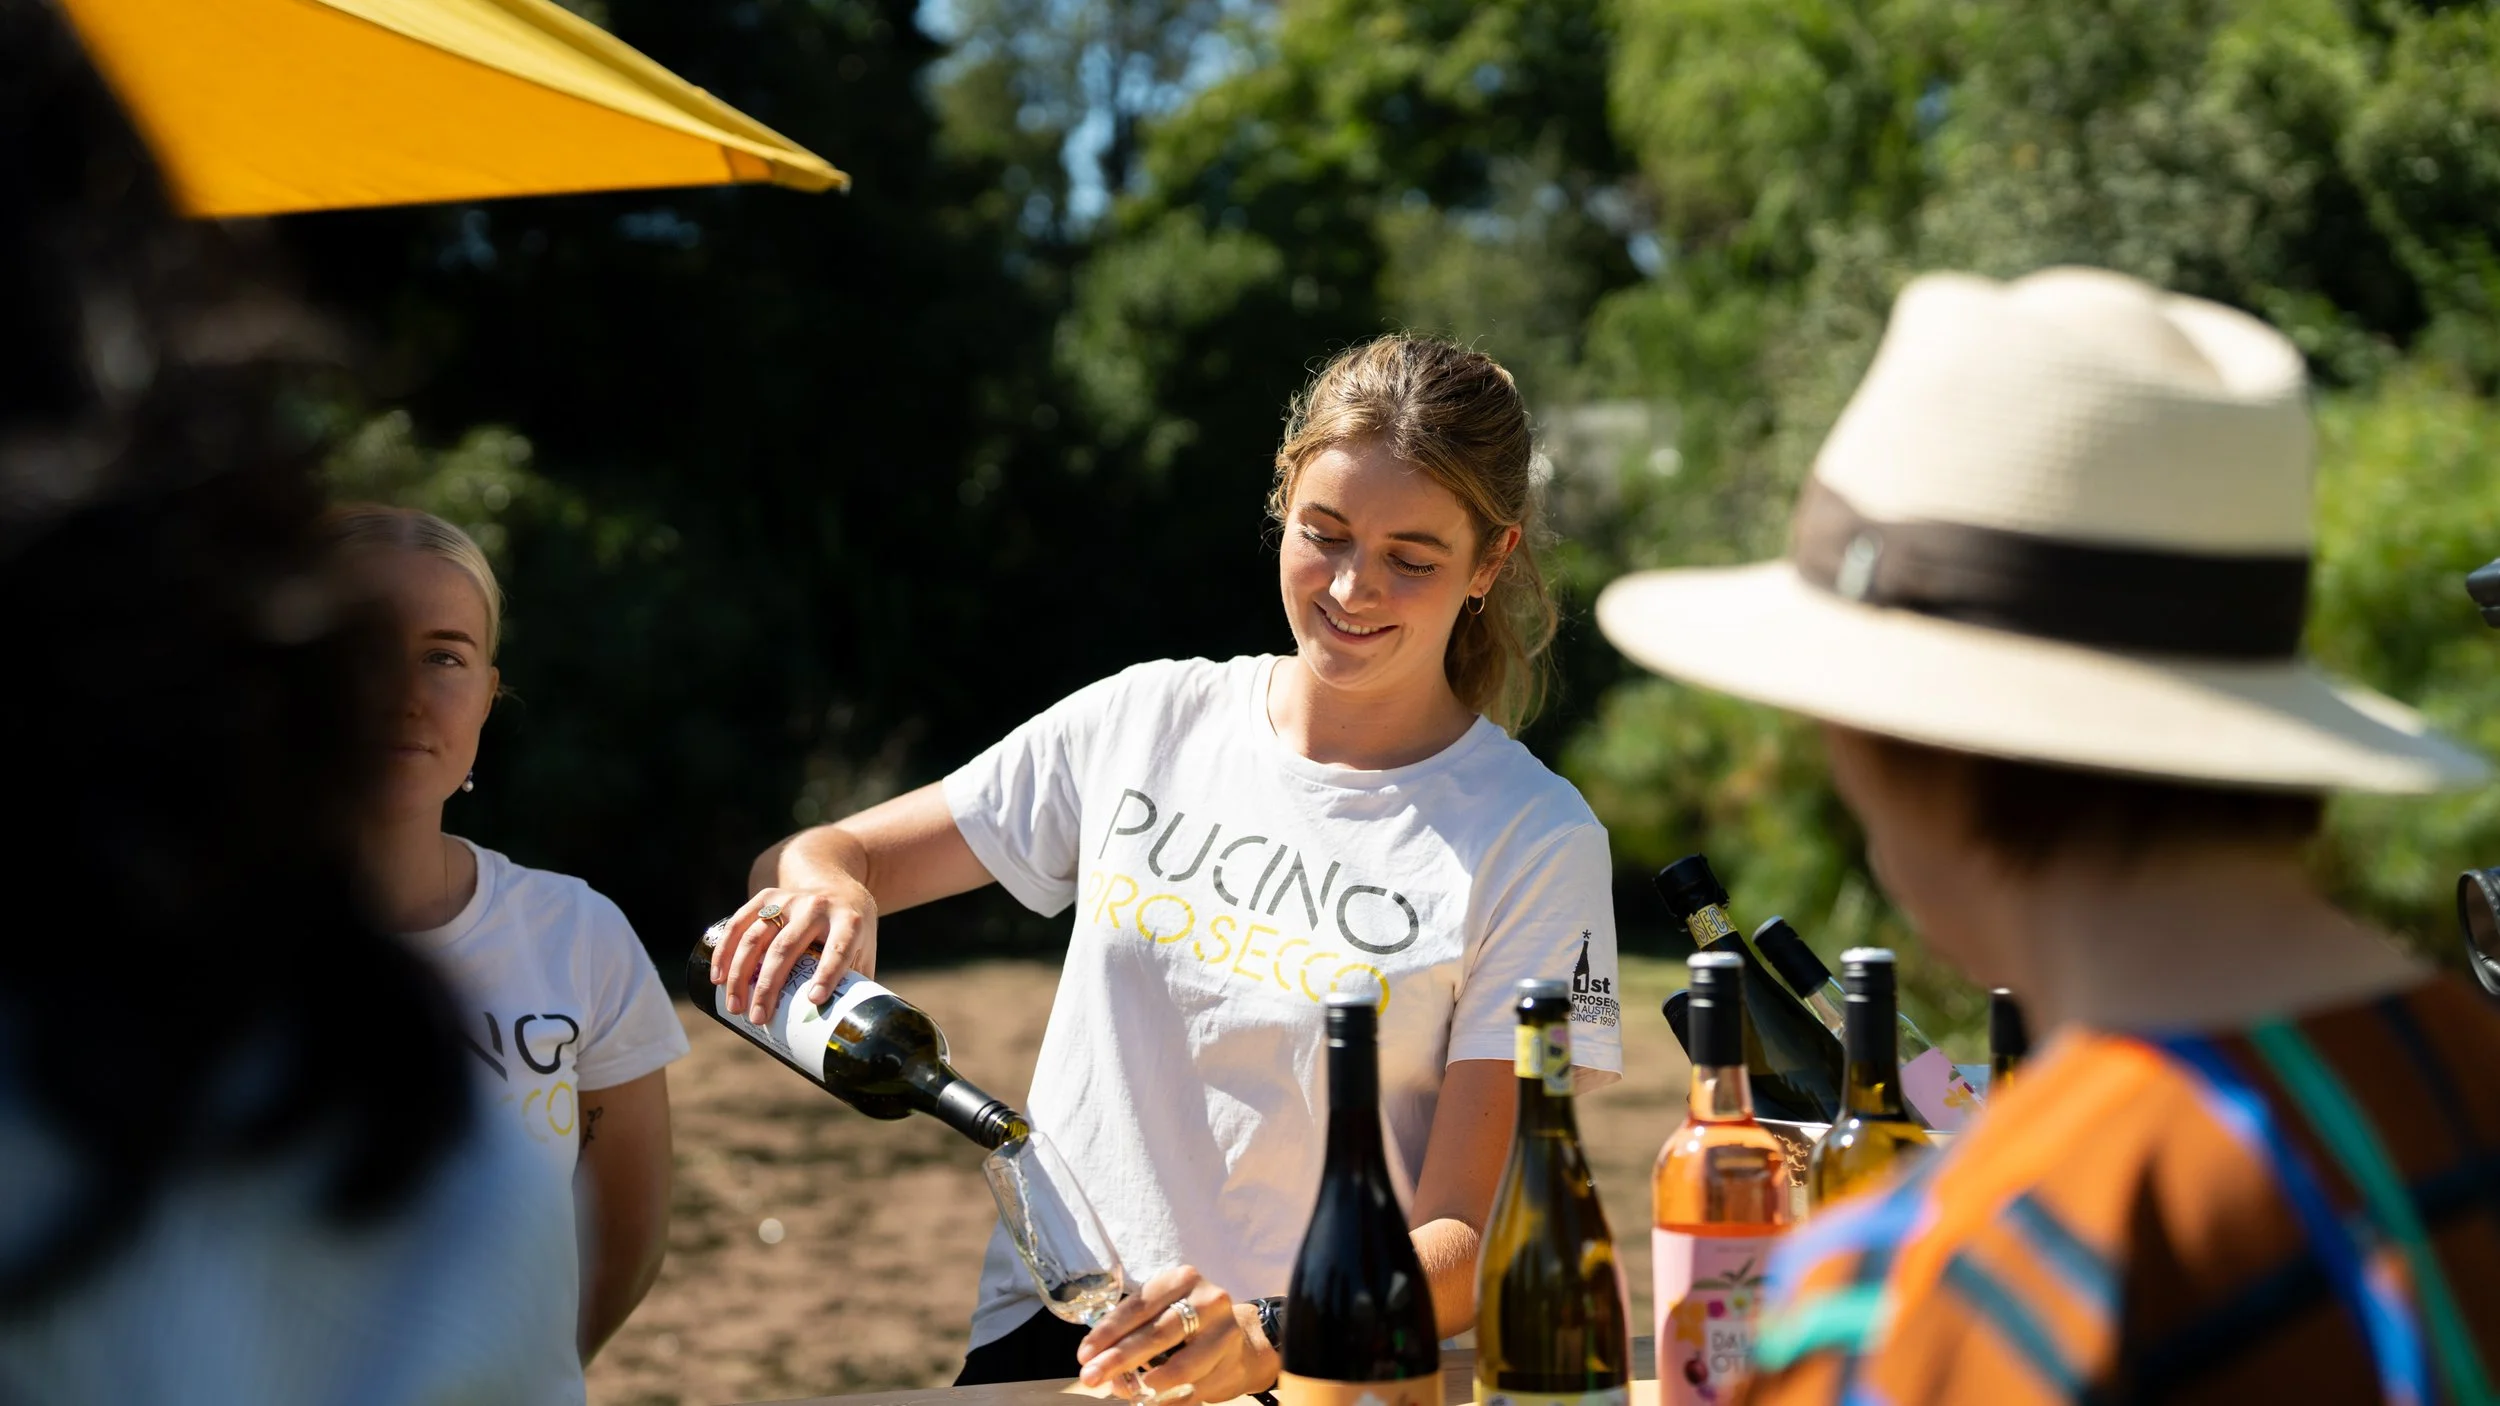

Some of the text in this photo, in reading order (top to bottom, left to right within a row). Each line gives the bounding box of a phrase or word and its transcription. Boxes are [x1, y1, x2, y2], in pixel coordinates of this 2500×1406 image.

[1099, 788, 1420, 955] PUCINO
[1576, 973, 1611, 994] 1st
[1570, 1012, 1616, 1028] SINCE 1999
